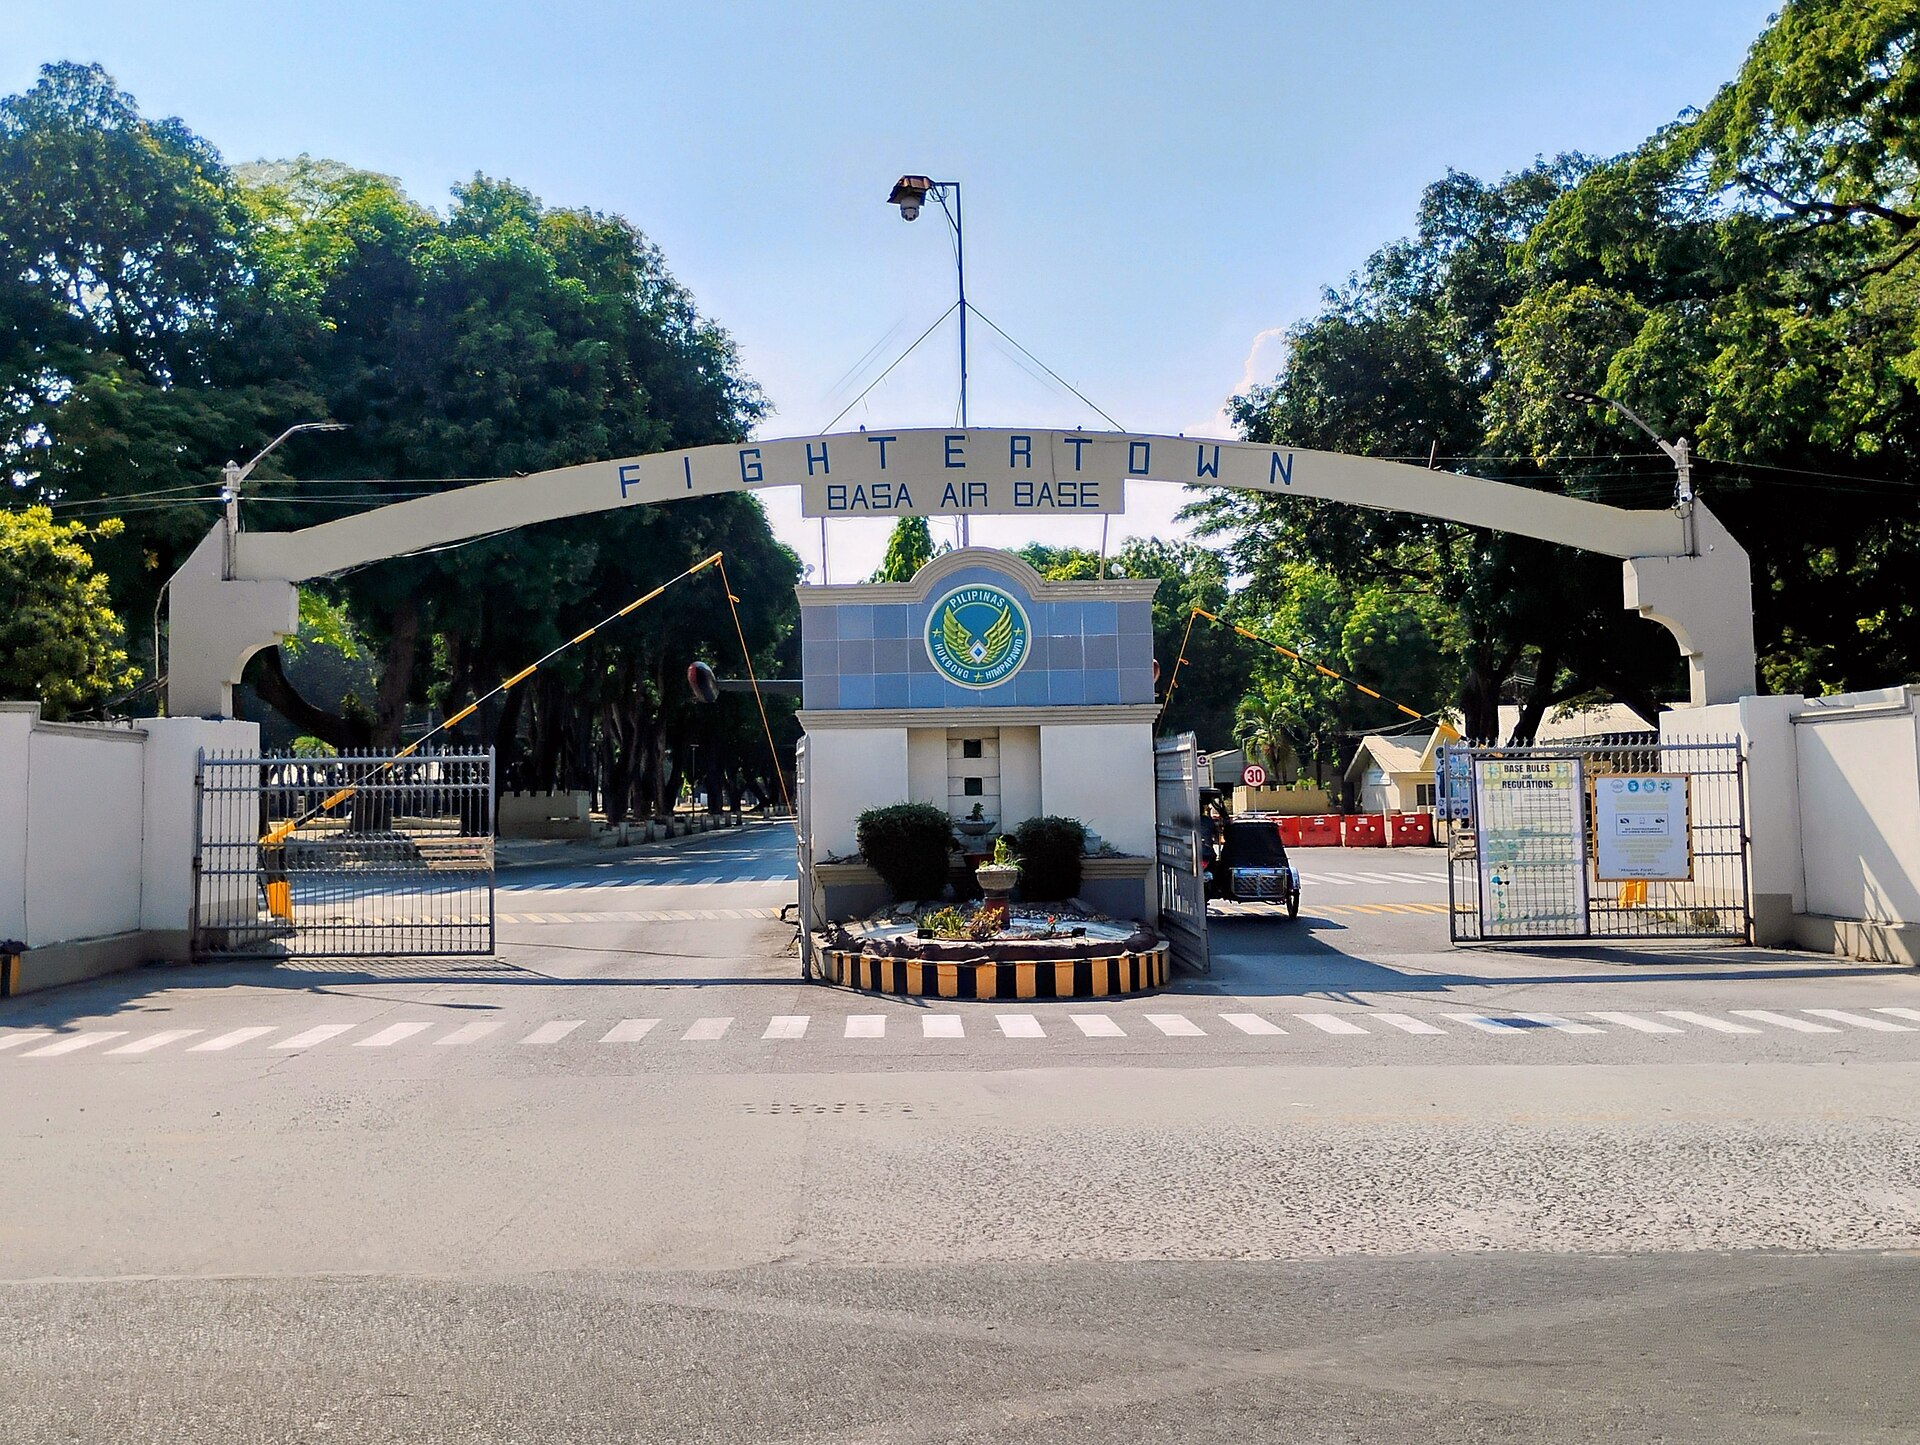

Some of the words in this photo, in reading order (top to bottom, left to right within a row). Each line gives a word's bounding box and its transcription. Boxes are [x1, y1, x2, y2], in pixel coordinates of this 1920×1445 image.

[618, 434, 1294, 499] FIGHTERTOWN
[827, 482, 913, 510] BASA
[940, 481, 988, 509] AIR
[1013, 481, 1100, 508] BASE
[949, 590, 1006, 608] PILIPINAS
[934, 643, 970, 679] HUKBONG
[985, 639, 1024, 680] HIMPAPAWID
[1247, 769, 1263, 783] 30
[1504, 764, 1524, 773] BASE
[1526, 764, 1550, 773] RULES
[1502, 780, 1554, 789] REGULATIONS
